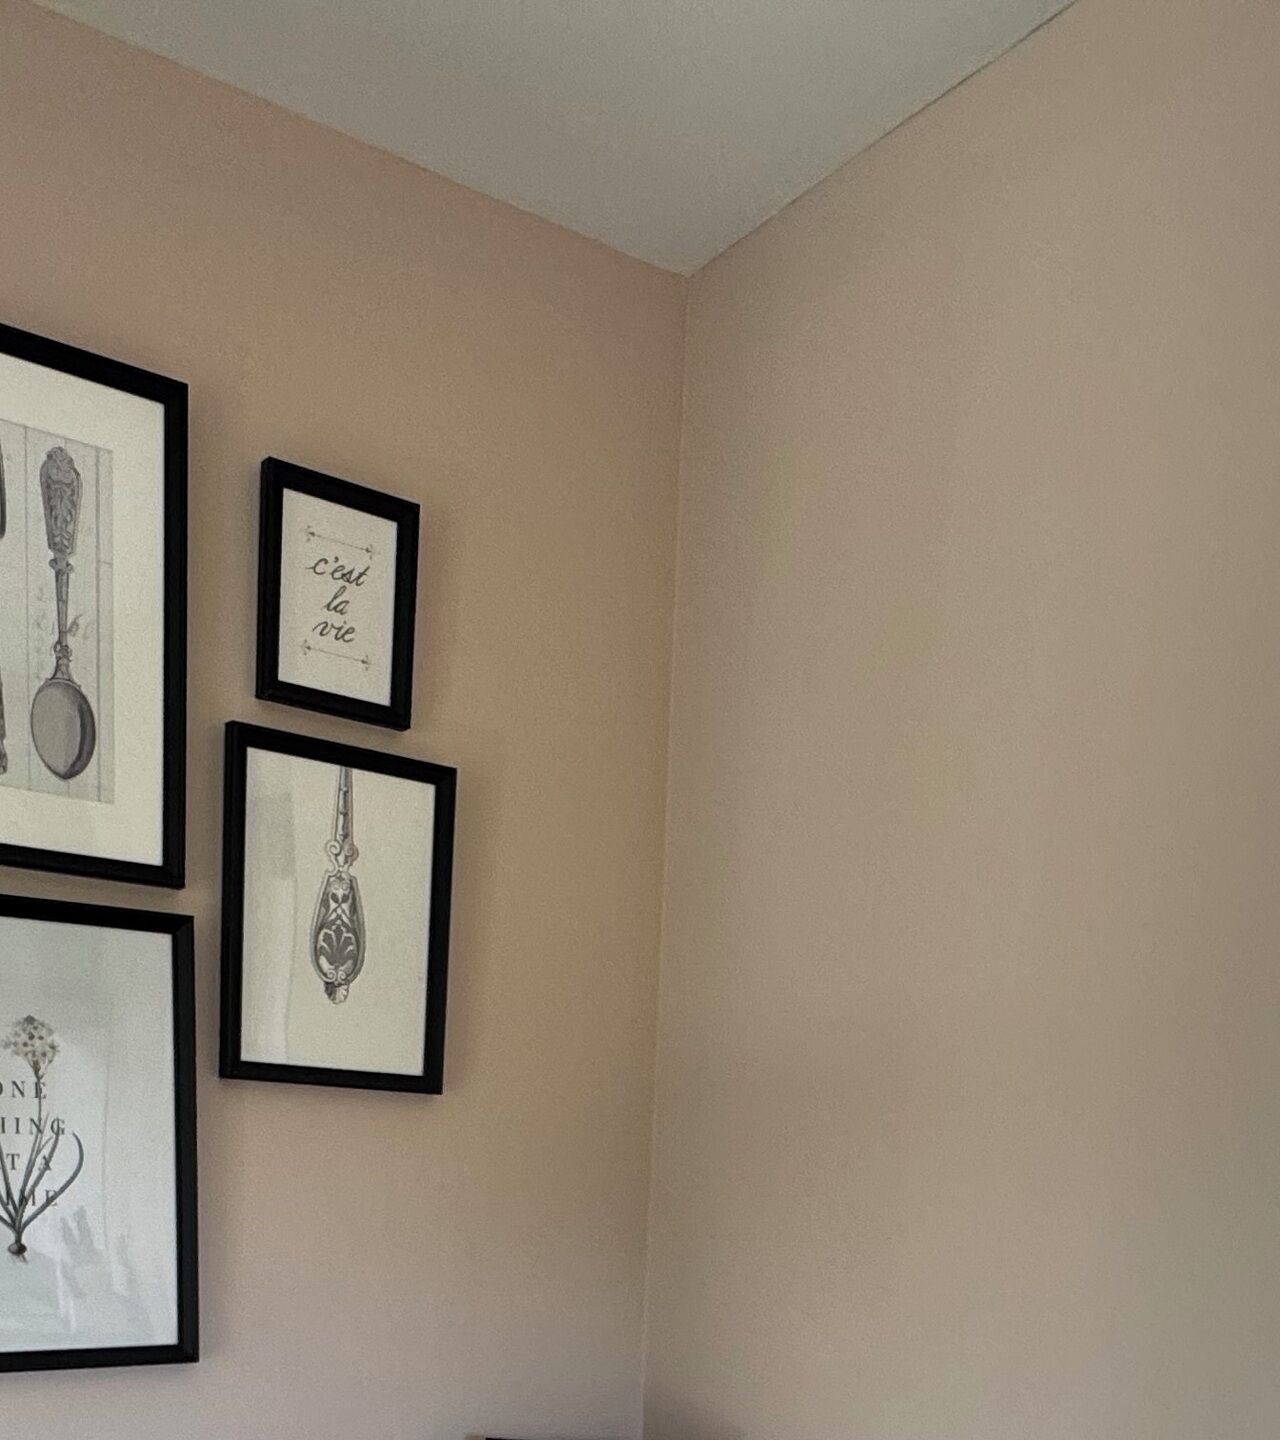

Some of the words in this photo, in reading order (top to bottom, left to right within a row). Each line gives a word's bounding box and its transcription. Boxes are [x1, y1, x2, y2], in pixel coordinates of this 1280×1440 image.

[305, 556, 370, 587] c'est
[323, 585, 350, 615] la
[312, 620, 356, 643] vie
